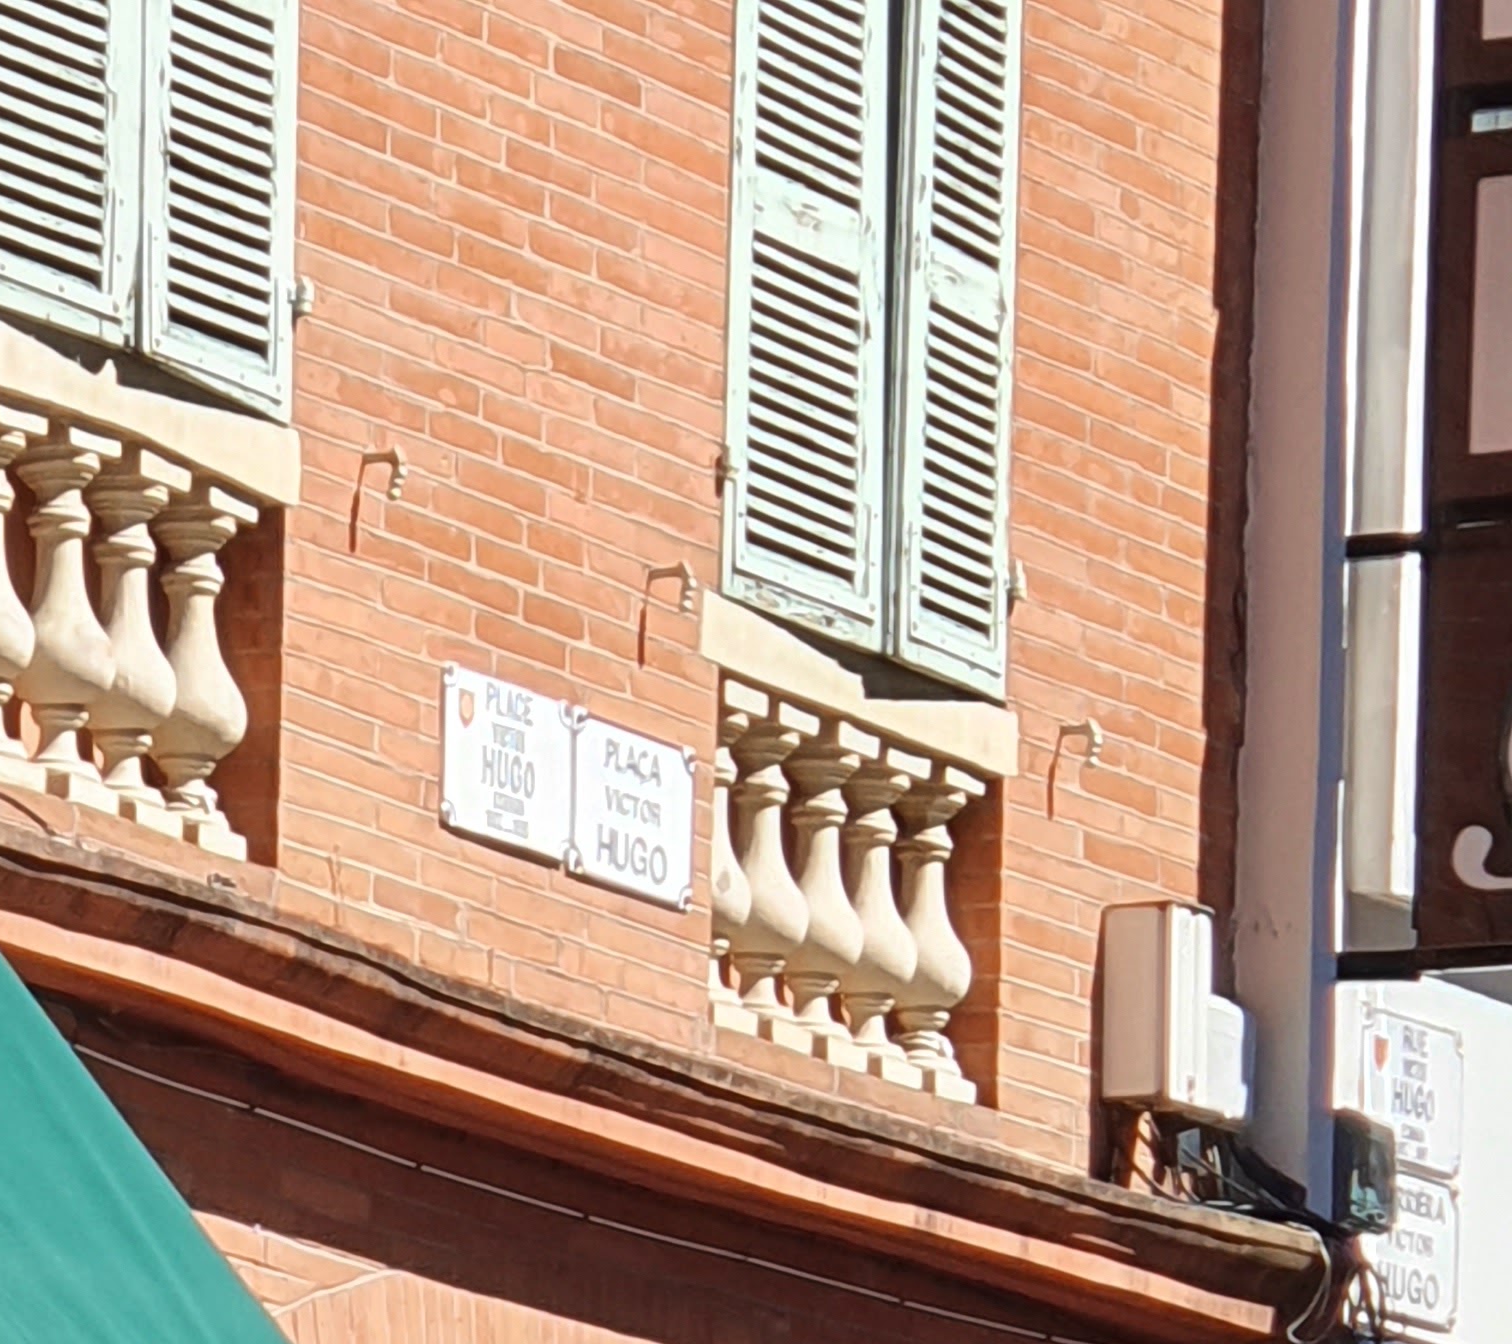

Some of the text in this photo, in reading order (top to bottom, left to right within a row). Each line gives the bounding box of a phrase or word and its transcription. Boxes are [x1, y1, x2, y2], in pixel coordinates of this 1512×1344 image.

[486, 681, 534, 727] PLACE
[480, 745, 536, 800] HUGO
[604, 785, 662, 829] VICTOR
[596, 823, 668, 886] HUGO
[1391, 1076, 1435, 1122] HUGO
[1377, 1260, 1440, 1310] HUGO
